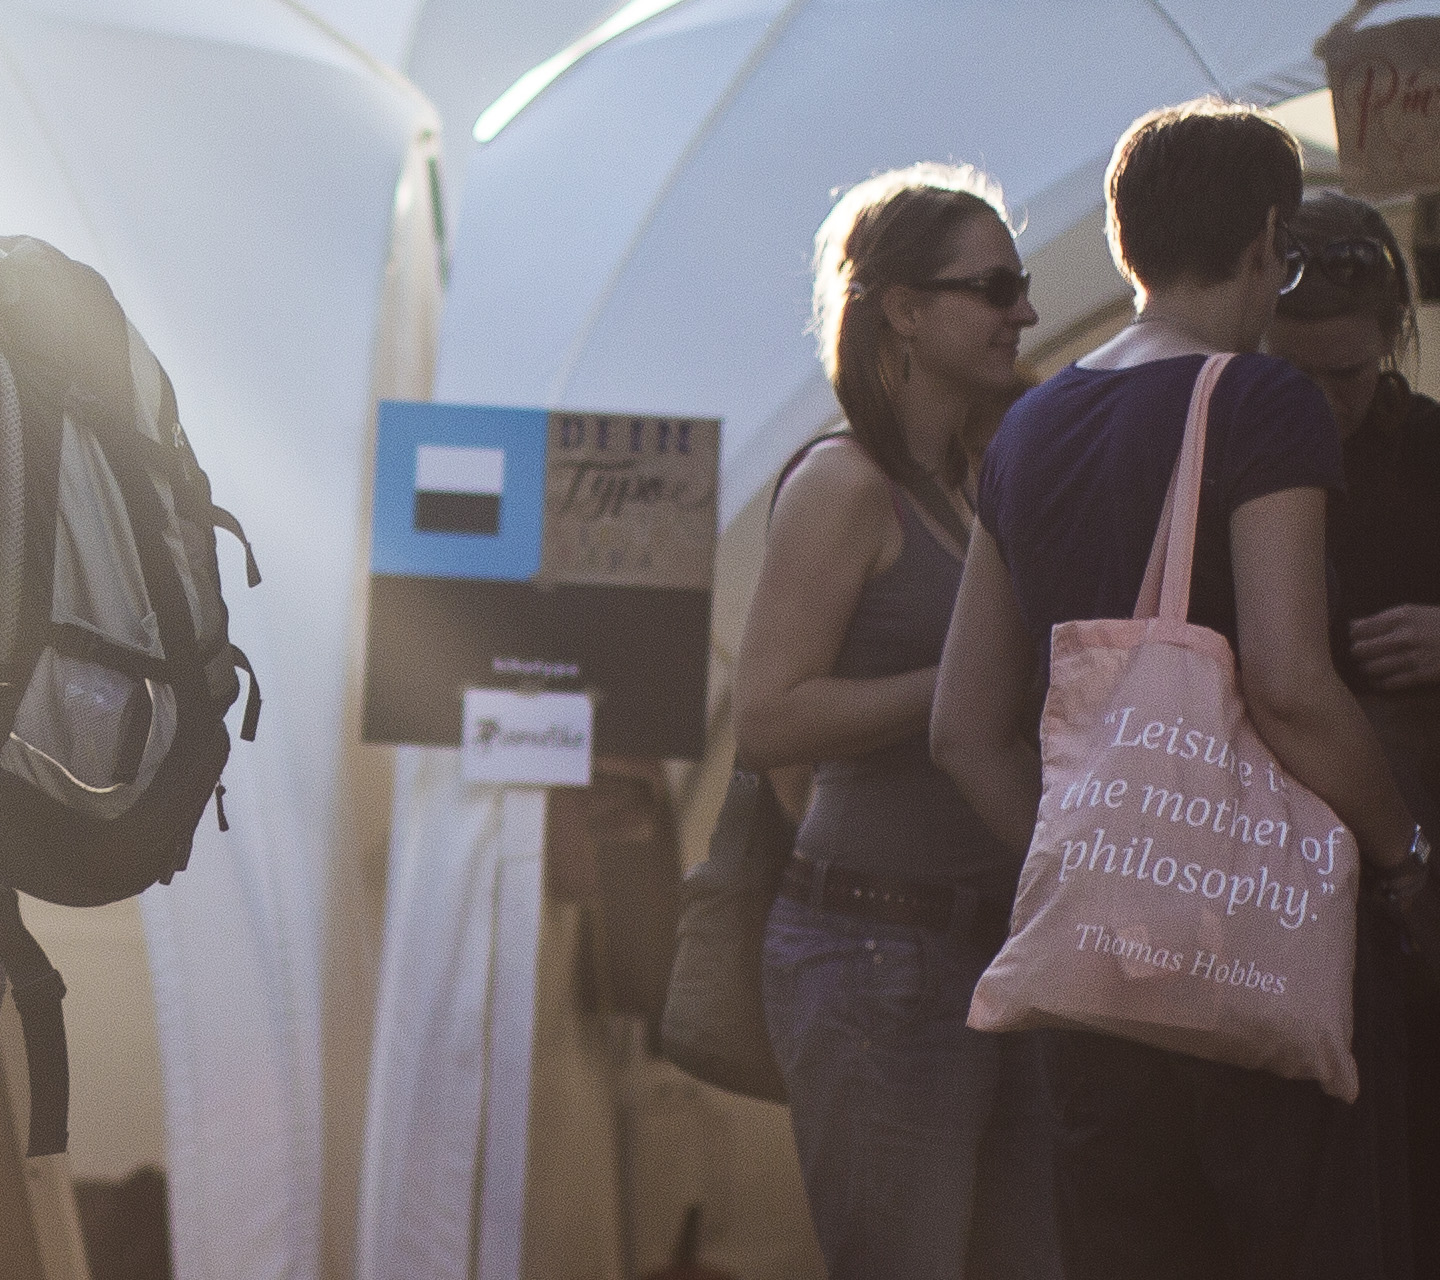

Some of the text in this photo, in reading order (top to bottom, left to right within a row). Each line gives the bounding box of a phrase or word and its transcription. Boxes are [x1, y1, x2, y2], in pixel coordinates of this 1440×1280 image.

[1140, 783, 1291, 848] mother
[1300, 825, 1346, 875] of
[1075, 922, 1289, 995] Thomas Hobbes
